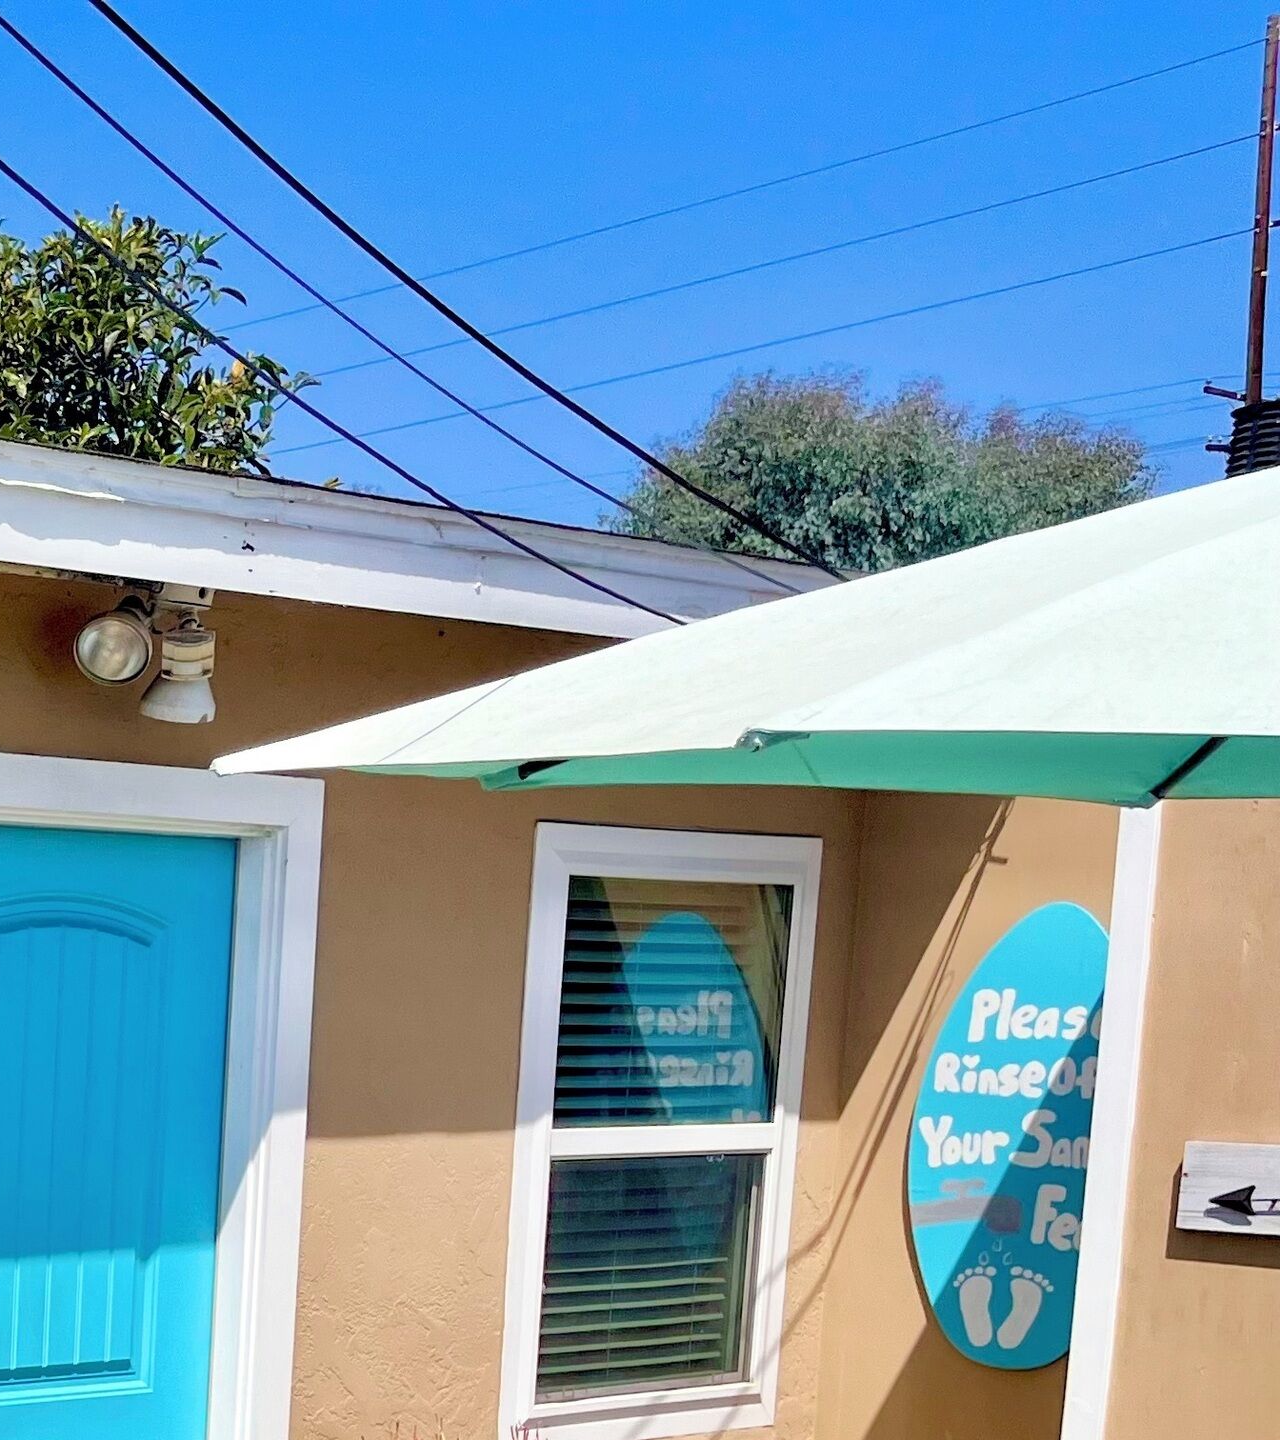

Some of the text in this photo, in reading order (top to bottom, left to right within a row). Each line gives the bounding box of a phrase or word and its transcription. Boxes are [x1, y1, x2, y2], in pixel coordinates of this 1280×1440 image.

[934, 1052, 1046, 1099] Rinse
[918, 1109, 1090, 1169] Your San
